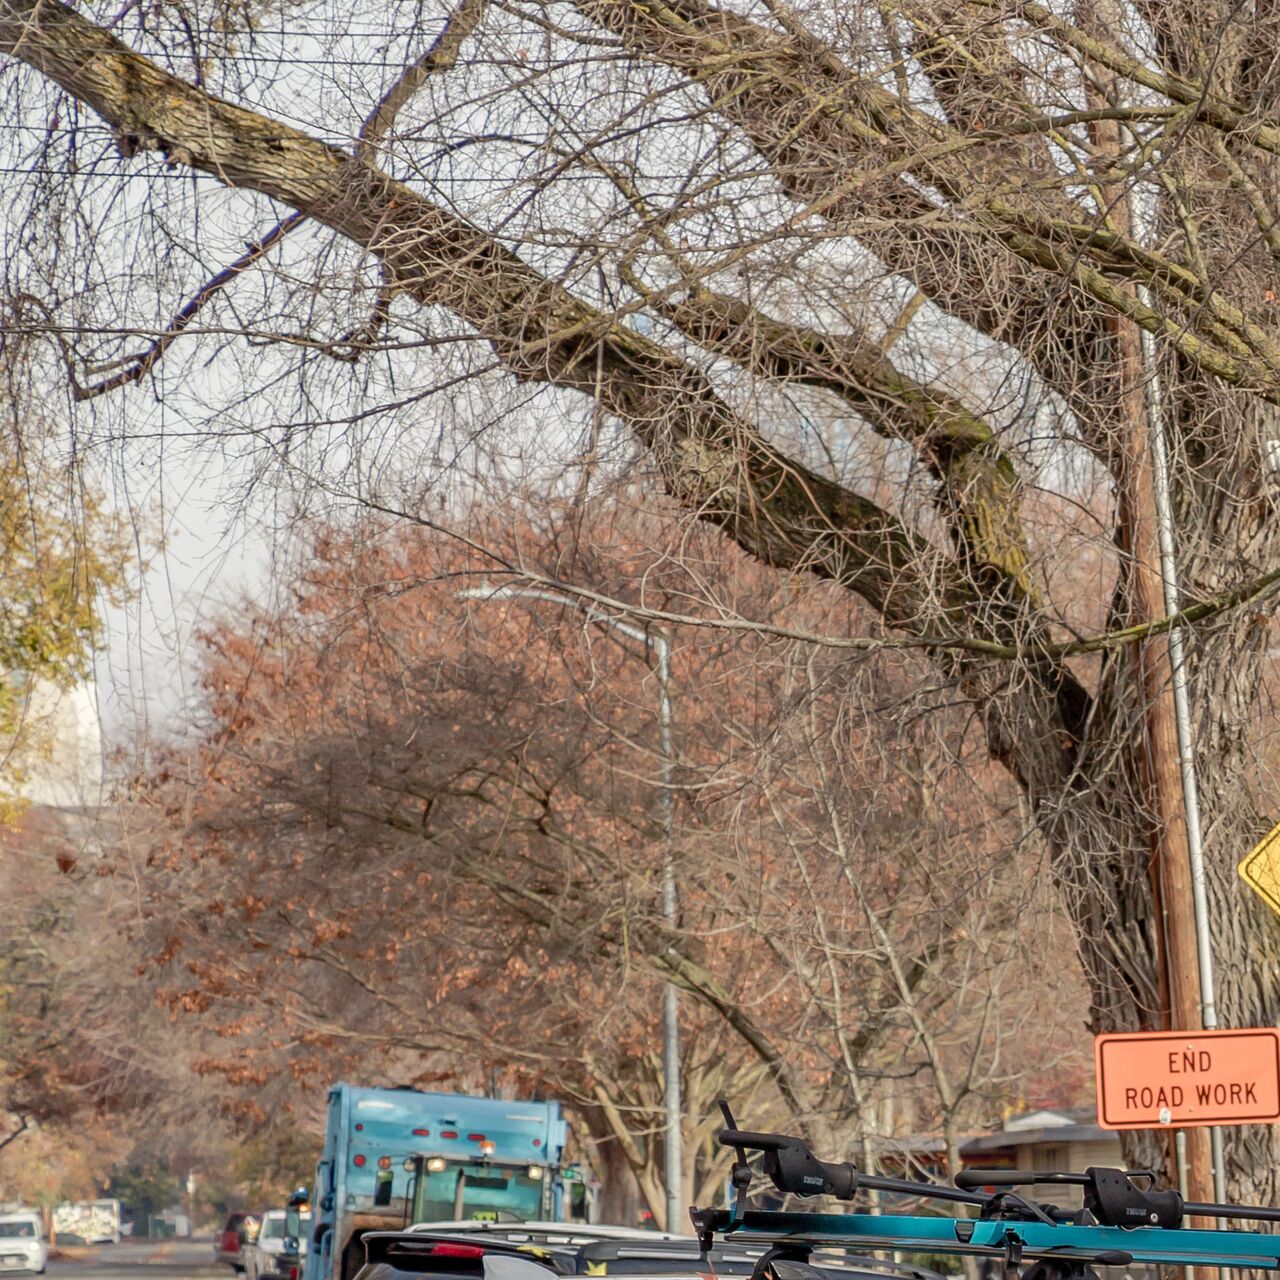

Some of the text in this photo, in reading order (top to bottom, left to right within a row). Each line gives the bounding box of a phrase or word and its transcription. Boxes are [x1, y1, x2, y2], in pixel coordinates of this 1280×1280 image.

[1169, 1051, 1211, 1073] END
[1125, 1082, 1258, 1109] ROAD WORK
